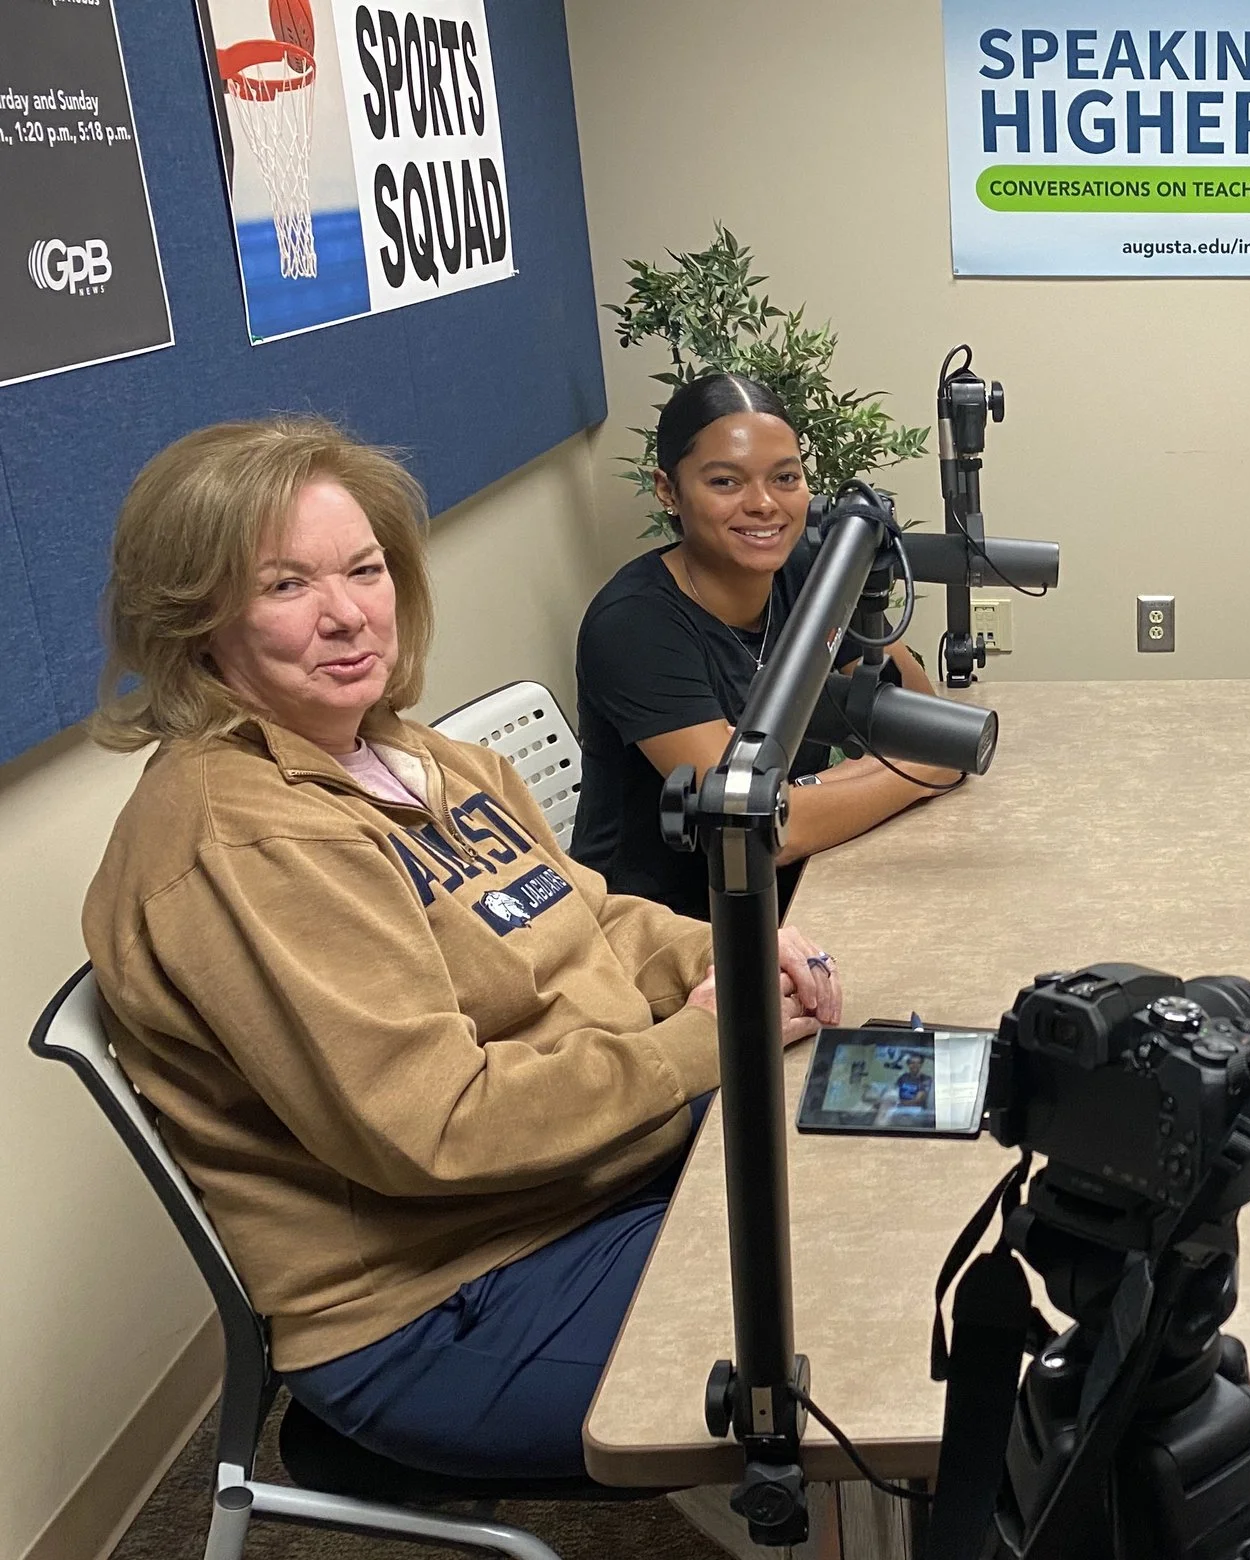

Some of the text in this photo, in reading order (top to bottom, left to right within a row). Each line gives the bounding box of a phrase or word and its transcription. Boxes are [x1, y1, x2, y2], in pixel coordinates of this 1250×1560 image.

[355, 5, 485, 140] SPORTS
[0, 87, 98, 116] rday and Sunday
[15, 121, 44, 142] 1:20
[47, 126, 77, 148] p.m.,
[77, 121, 104, 141] 5:18
[105, 126, 131, 147] p.m.
[990, 180, 1150, 197] CONVERSATIONS
[1157, 181, 1186, 197] ON
[374, 157, 507, 289] SQUAD
[79, 285, 105, 297] NEWS
